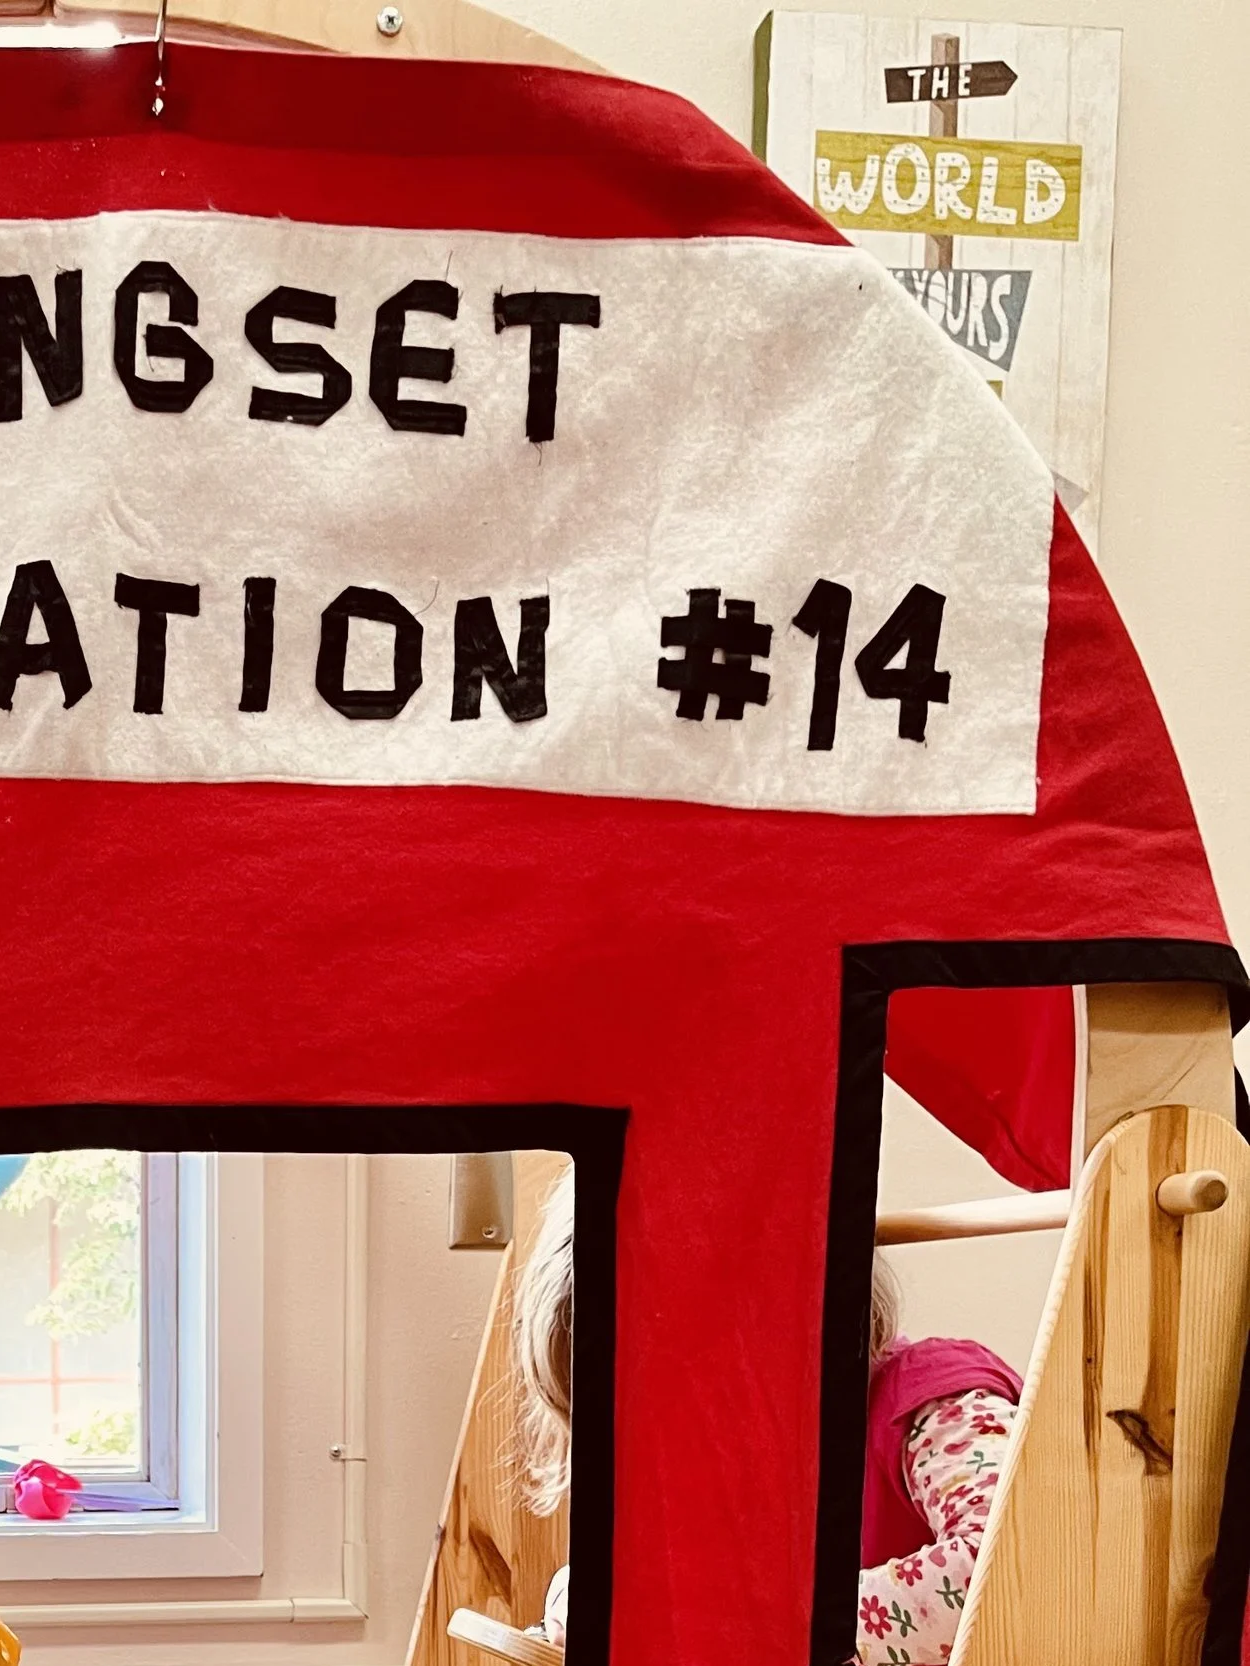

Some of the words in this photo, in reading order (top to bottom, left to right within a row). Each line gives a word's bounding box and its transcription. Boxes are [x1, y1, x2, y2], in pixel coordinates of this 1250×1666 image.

[907, 64, 973, 99] THE
[816, 143, 1066, 225] WORLD
[656, 578, 952, 752] #14
